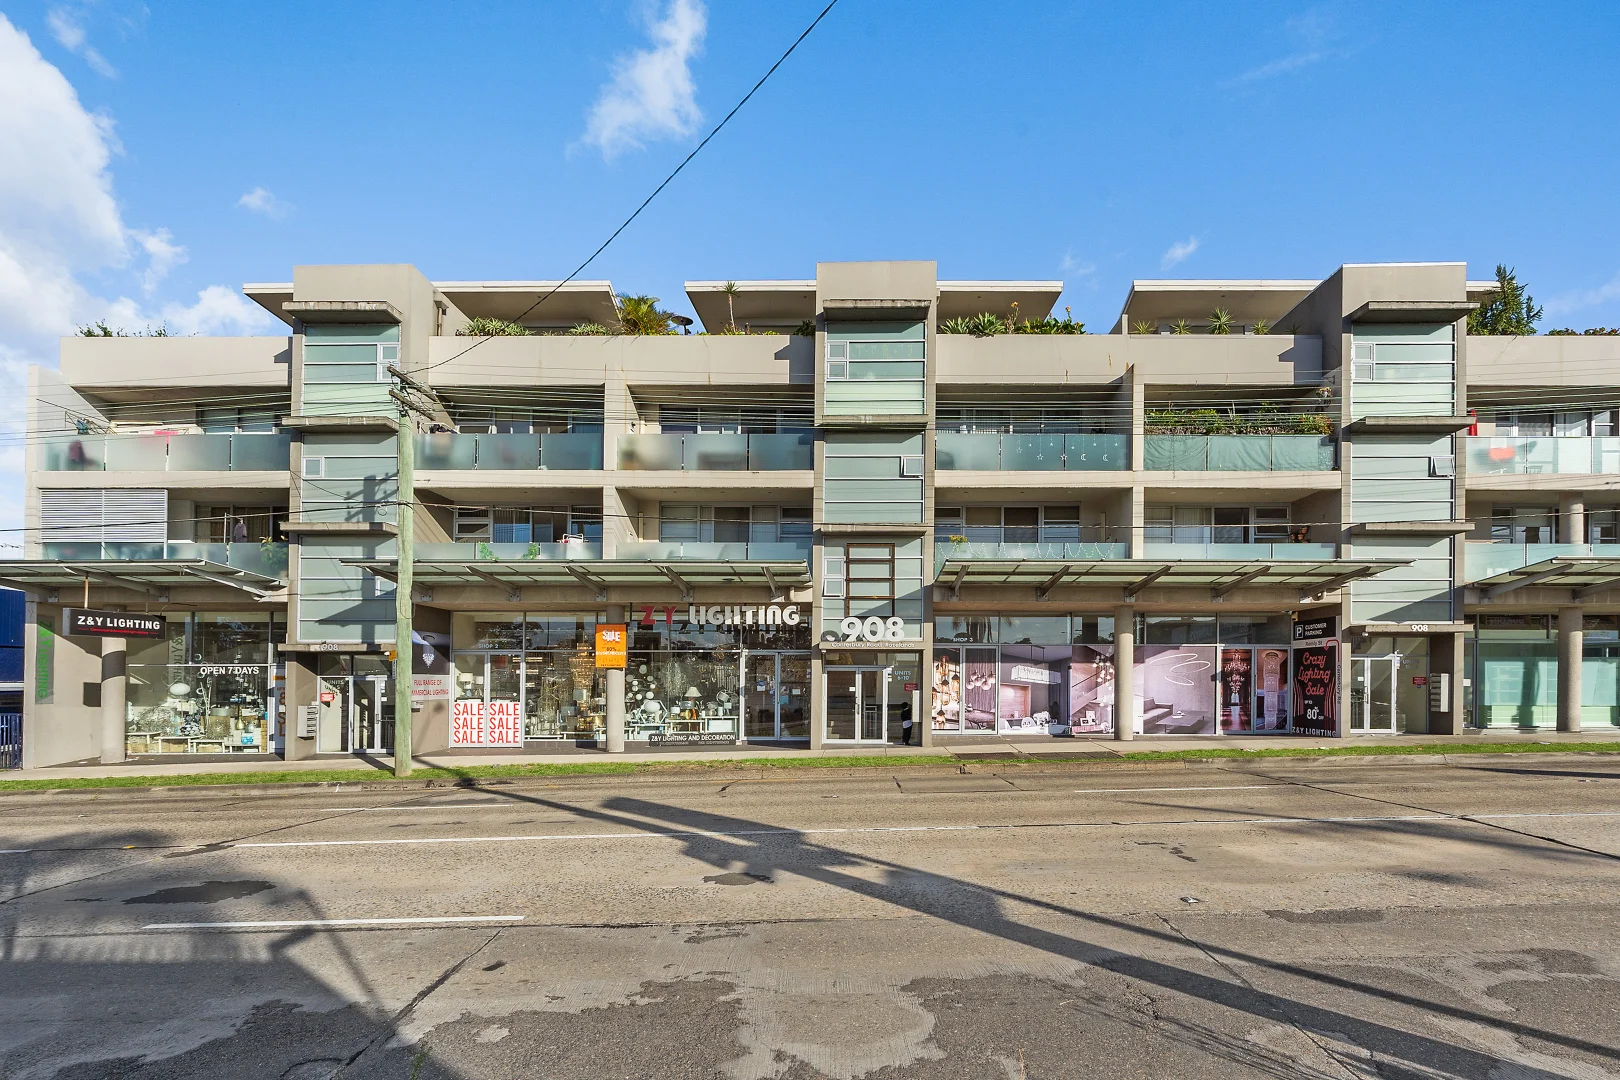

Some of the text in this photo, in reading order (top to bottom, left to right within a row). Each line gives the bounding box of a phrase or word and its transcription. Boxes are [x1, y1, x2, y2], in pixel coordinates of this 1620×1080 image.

[689, 605, 800, 626] LIGHTING
[77, 616, 160, 630] Z&Y LIGHTING
[840, 616, 905, 642] 908
[1411, 624, 1429, 632] 908
[602, 630, 621, 642] SALE
[320, 643, 339, 651] 908
[1302, 652, 1327, 668] Crazy
[200, 666, 260, 675] OPEN 7 DAYS
[1298, 666, 1331, 683] Lighting
[433, 688, 449, 696] LIGHTING
[1305, 682, 1325, 695] Sale
[453, 703, 484, 716] SALE
[489, 703, 519, 716] SALE
[453, 717, 484, 730] SALE
[489, 717, 519, 730] SALE
[453, 730, 484, 743] SALE
[489, 730, 519, 743] SALE
[1305, 728, 1337, 737] LIGHTING
